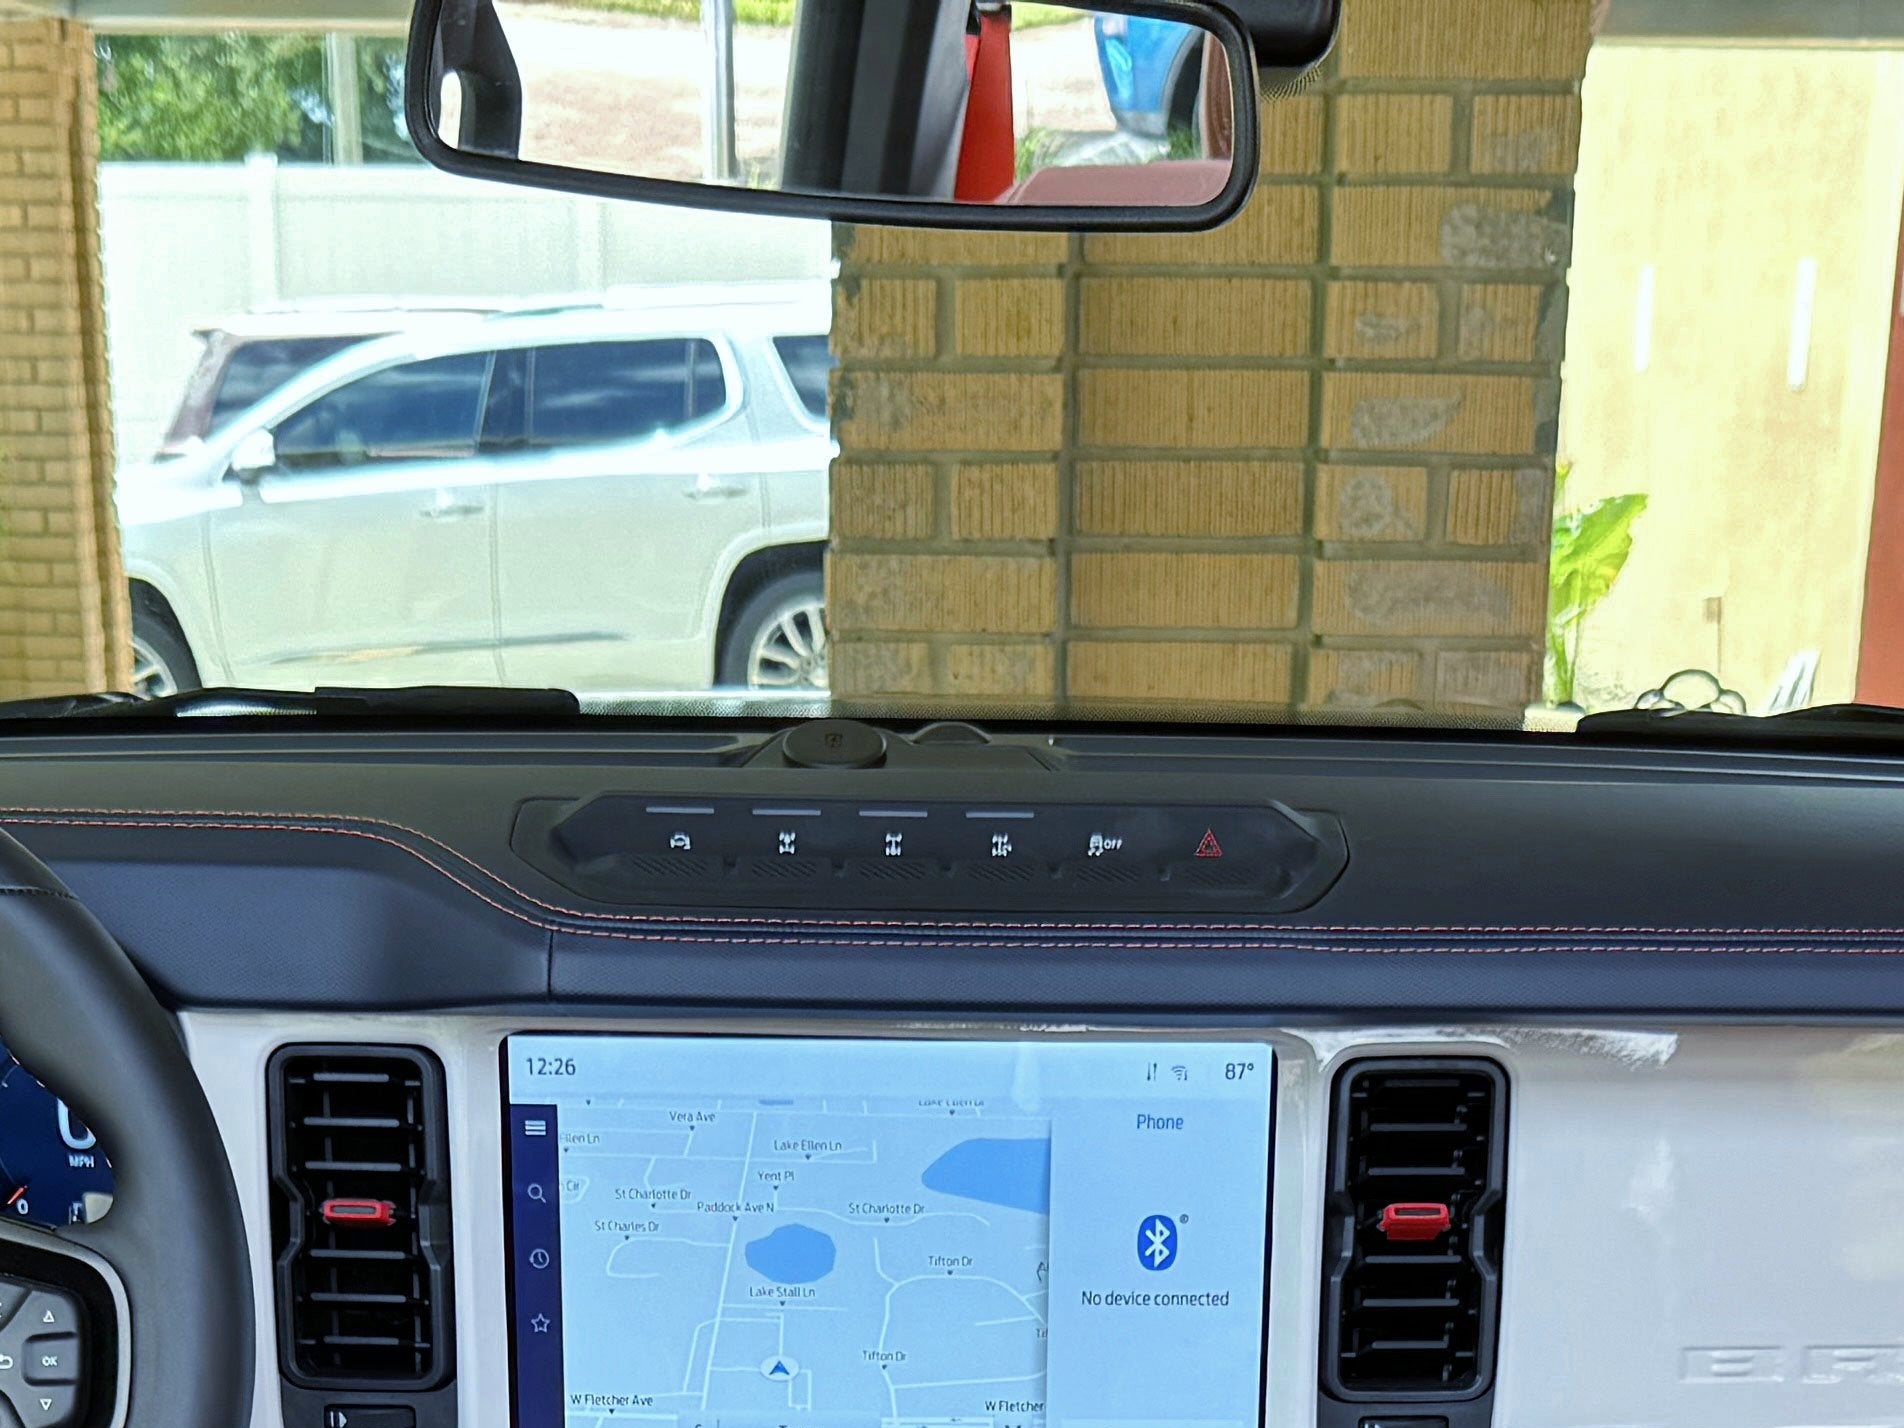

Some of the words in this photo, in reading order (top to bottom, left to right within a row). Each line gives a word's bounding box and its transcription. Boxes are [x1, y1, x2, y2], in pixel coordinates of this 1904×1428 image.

[526, 1057, 576, 1076] 12:26
[1224, 1062, 1255, 1081] 87°
[669, 1111, 694, 1122] Vera
[696, 1111, 716, 1123] Ave
[1136, 1114, 1185, 1131] Phone
[587, 1134, 600, 1144] Ln
[773, 1140, 798, 1152] Lake
[800, 1140, 828, 1152] Ellen
[829, 1140, 842, 1151] Ln
[757, 1171, 782, 1182] Yent
[615, 1188, 626, 1200] St
[628, 1188, 678, 1200] Charlotte
[680, 1189, 692, 1200] Dr
[16, 1199, 29, 1215] 0
[697, 1202, 742, 1213] Paddock
[744, 1202, 764, 1213] Ave
[766, 1203, 775, 1213] N
[848, 1202, 860, 1214] St
[862, 1202, 911, 1214] Charlotte
[913, 1203, 925, 1215] Dr
[595, 1221, 606, 1232] St
[608, 1221, 646, 1232] Charles
[648, 1222, 659, 1232] Dr
[928, 1255, 959, 1267] Tifton
[961, 1255, 973, 1267] Dr
[749, 1287, 774, 1298] Lake
[776, 1286, 800, 1298] Stall
[802, 1287, 816, 1298] Ln
[1081, 1290, 1102, 1307] No
[1104, 1290, 1151, 1307] device
[1153, 1290, 1230, 1307] connected
[41, 1355, 58, 1367] OK
[862, 1350, 893, 1362] Tifton
[895, 1351, 907, 1362] Dr
[570, 1394, 582, 1405] W
[584, 1394, 630, 1406] Fletcher
[632, 1394, 654, 1406] Ave
[985, 1400, 996, 1412] W
[998, 1400, 1045, 1413] Fletcher
